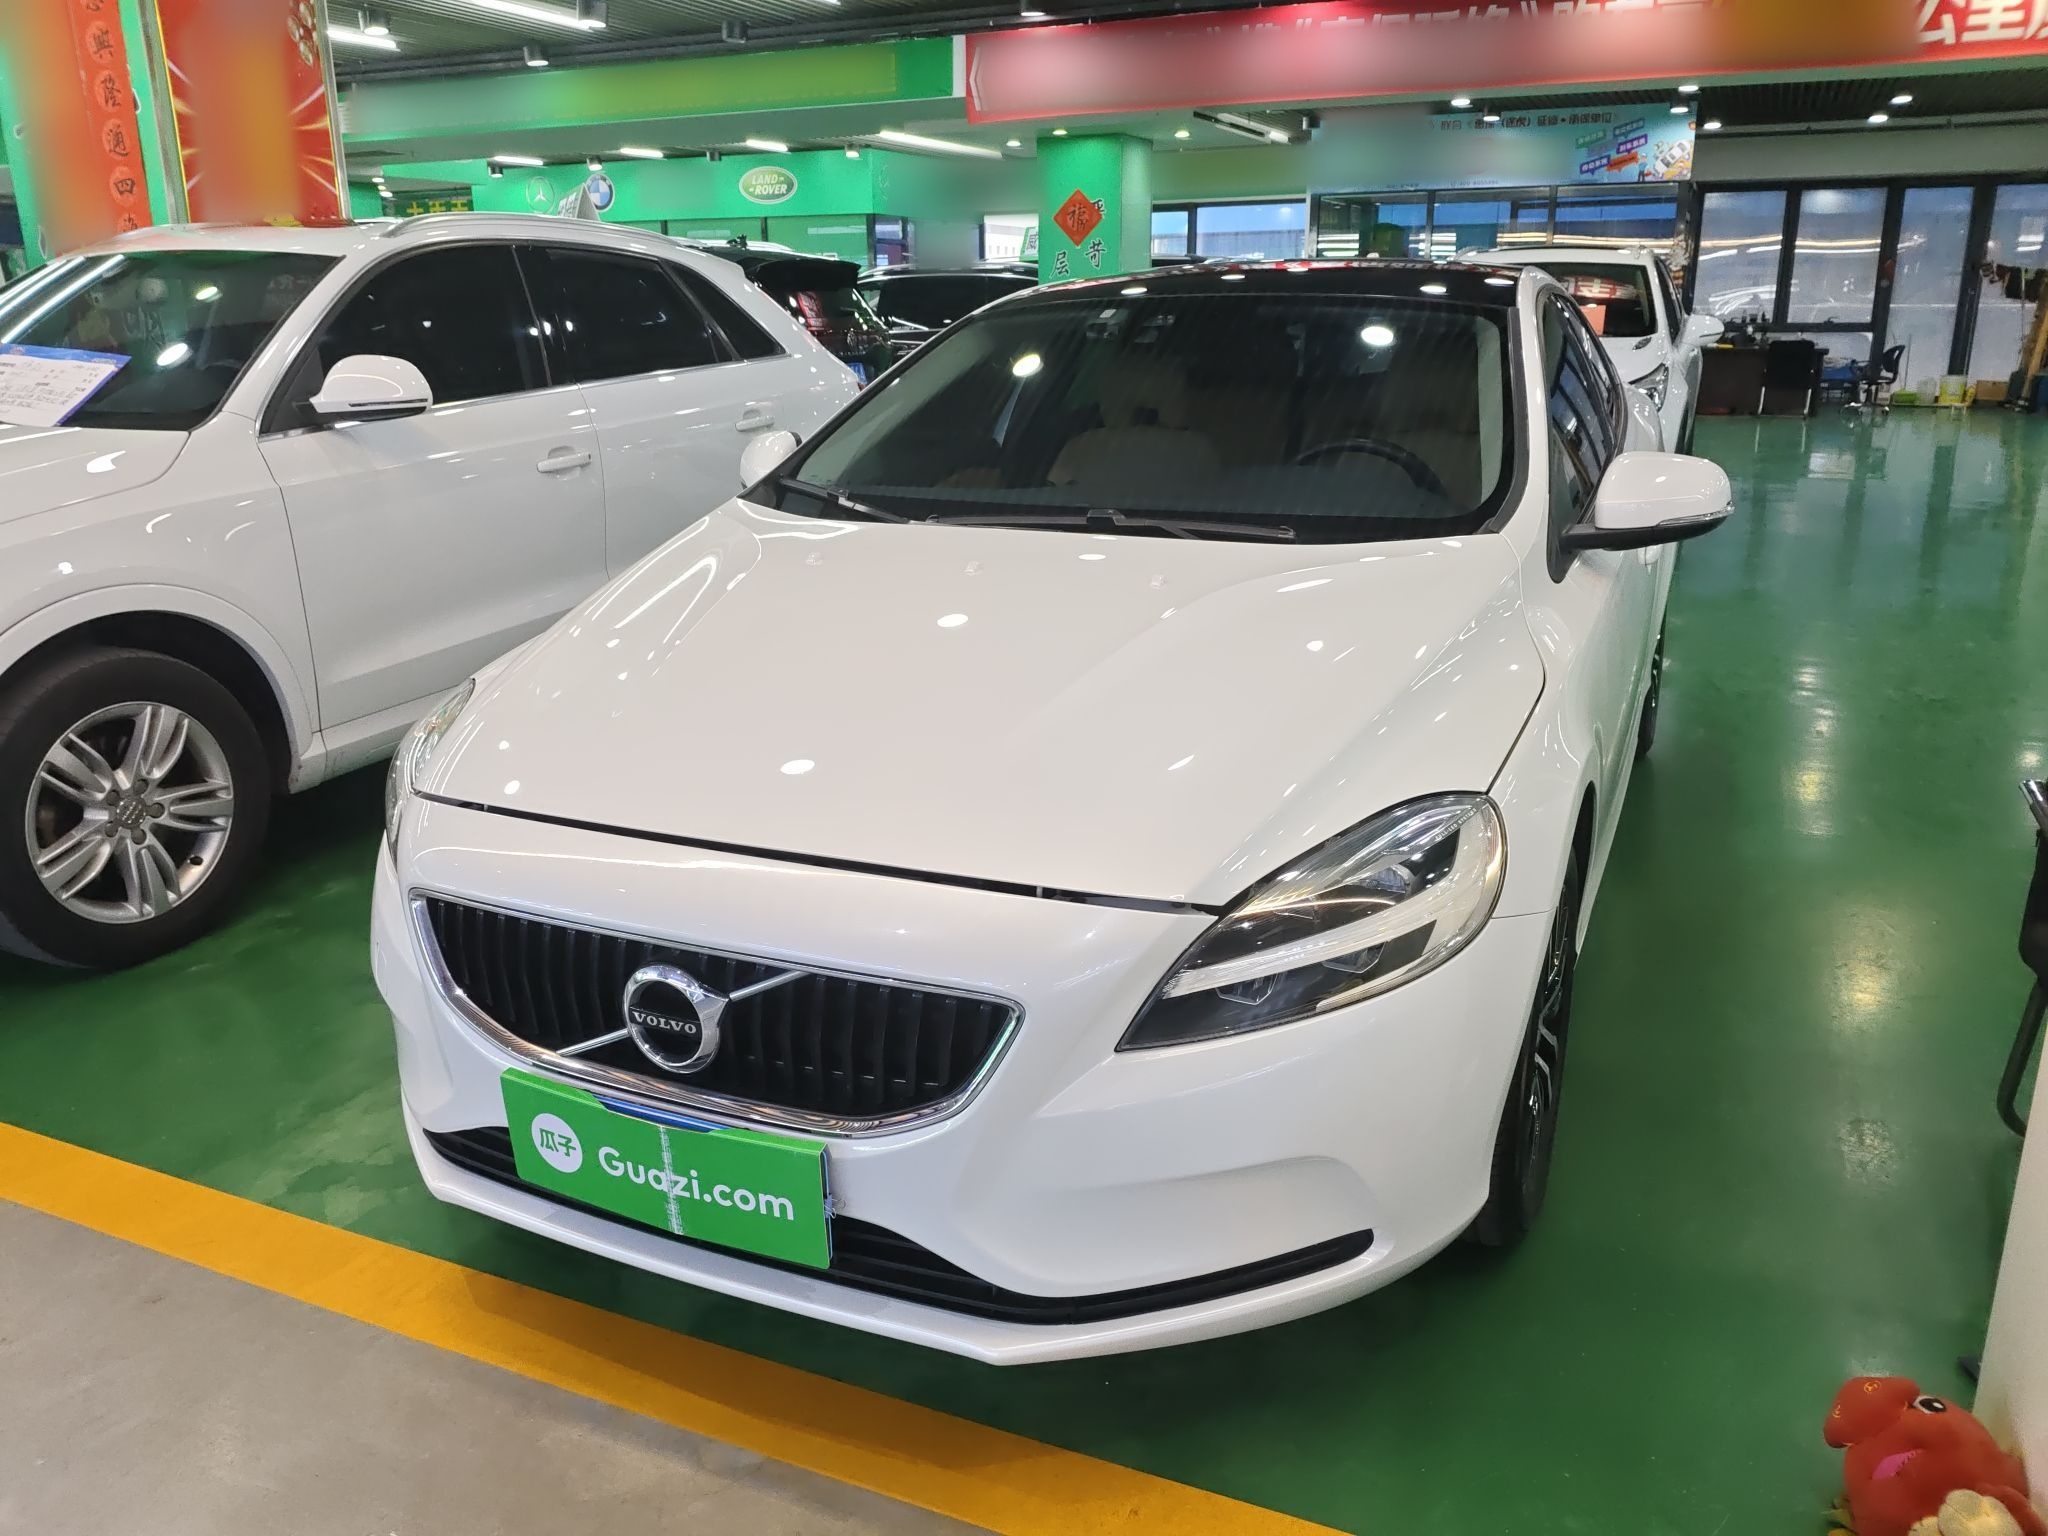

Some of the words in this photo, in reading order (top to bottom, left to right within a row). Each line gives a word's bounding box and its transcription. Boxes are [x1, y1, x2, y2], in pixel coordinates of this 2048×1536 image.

[755, 184, 788, 195] ROVER
[1050, 251, 1069, 278] 层
[632, 1011, 697, 1034] VOLVO
[539, 1127, 577, 1157] 瓜子
[598, 1146, 794, 1221] Guazi.com
